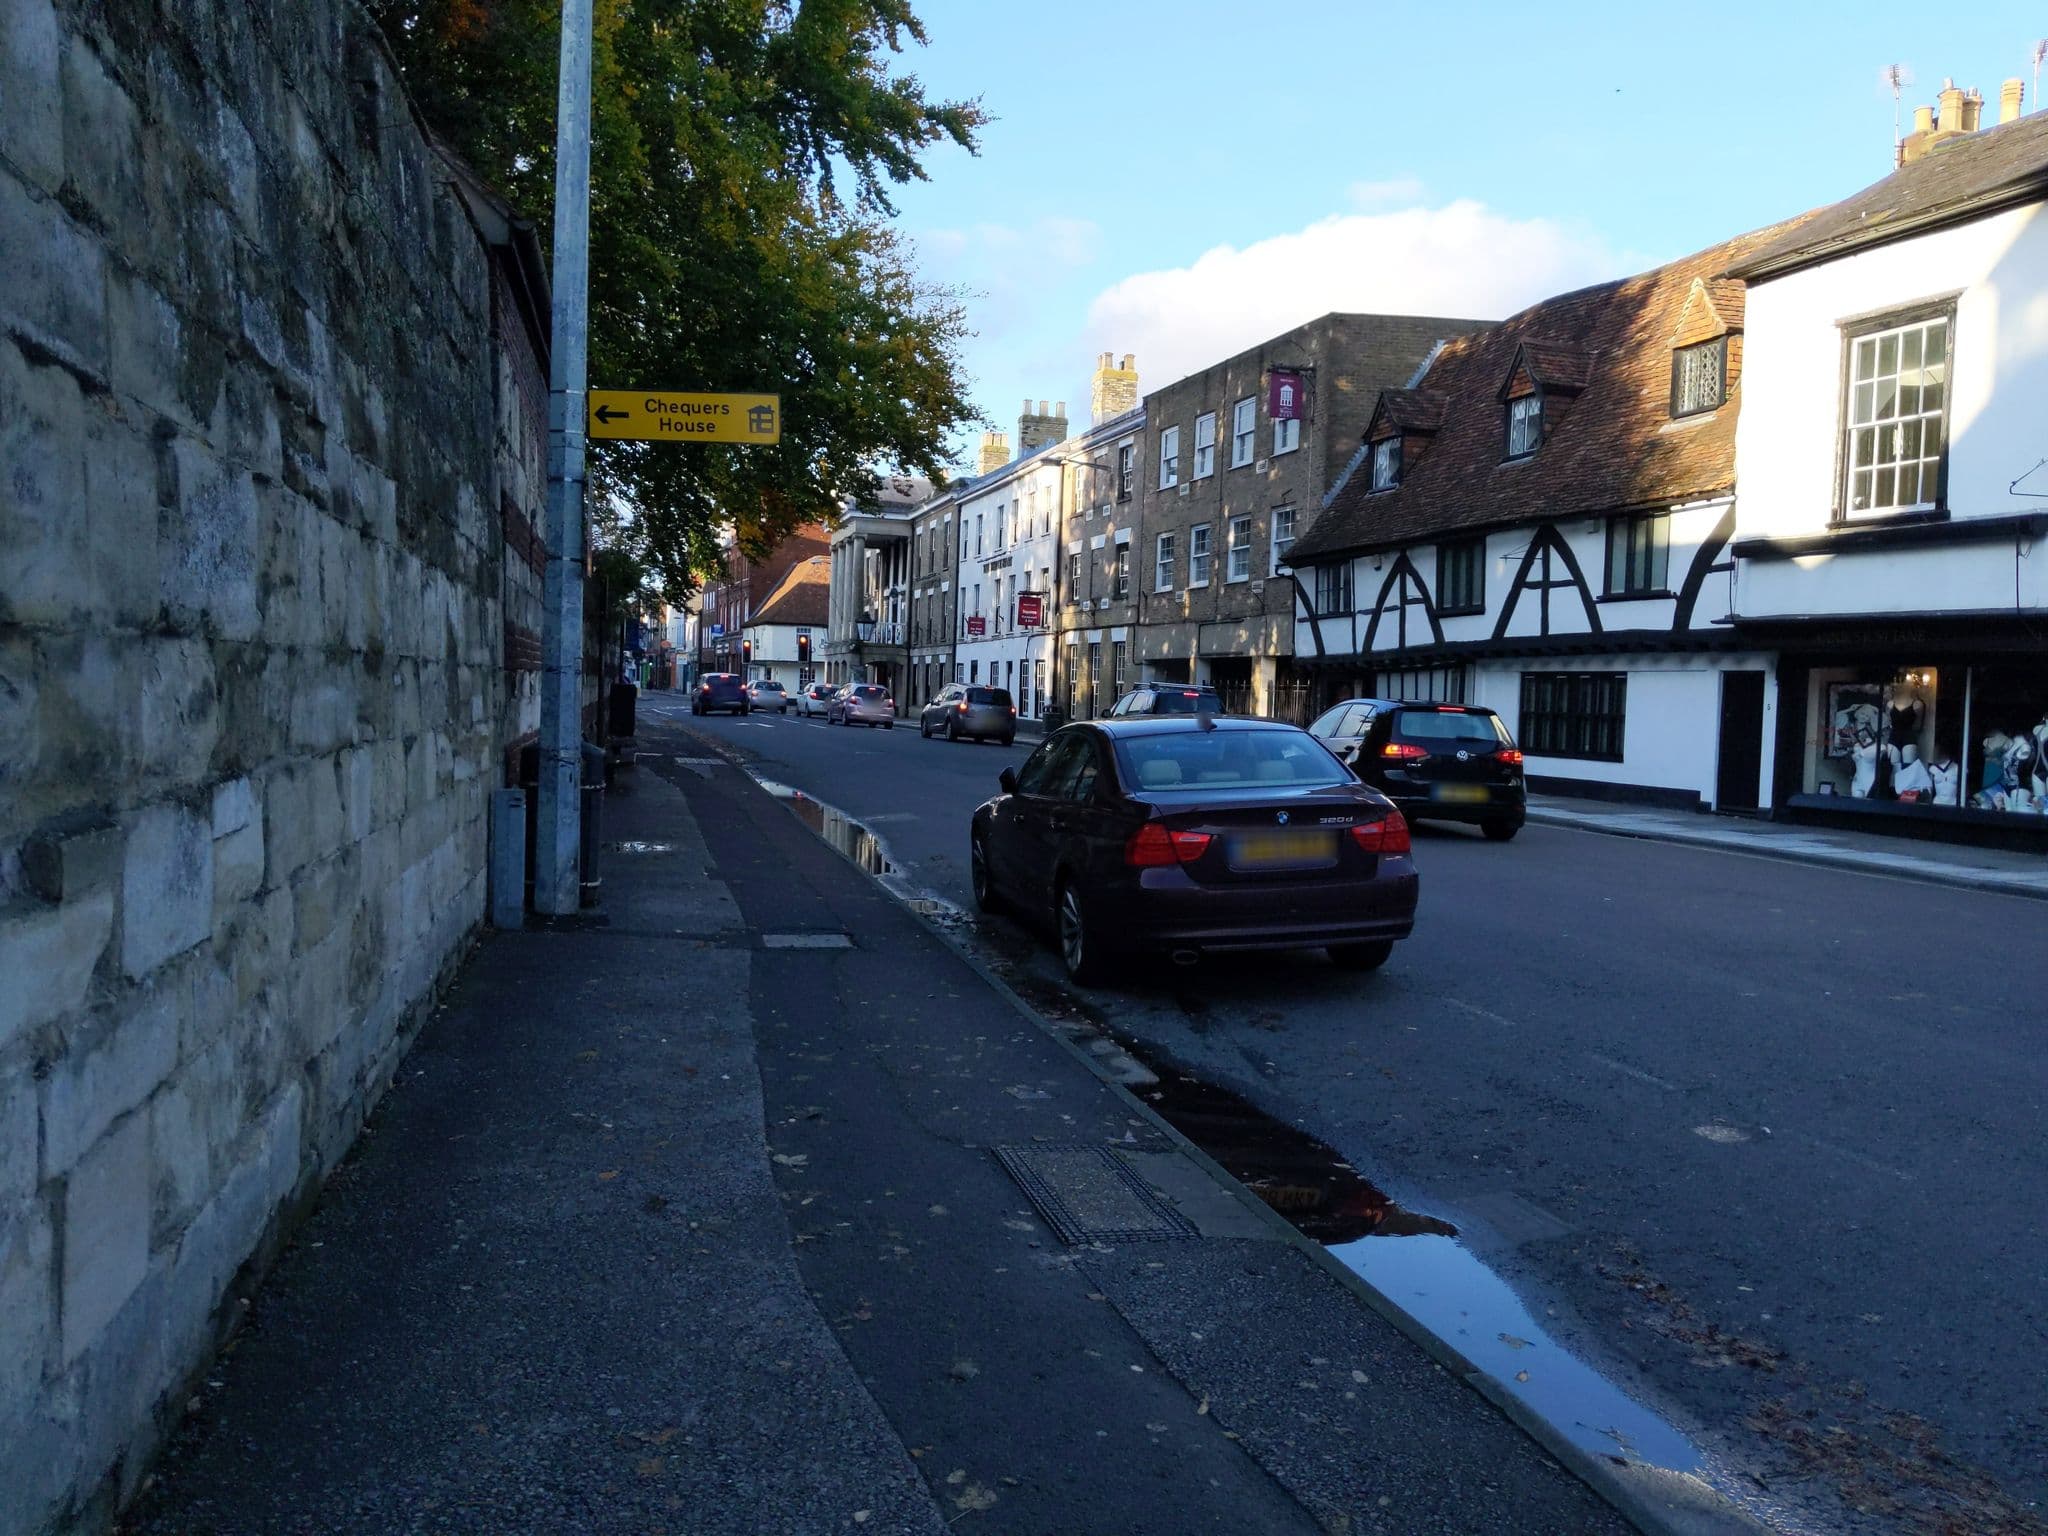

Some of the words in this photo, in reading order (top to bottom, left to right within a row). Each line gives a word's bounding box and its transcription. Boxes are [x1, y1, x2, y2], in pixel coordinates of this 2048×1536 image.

[645, 398, 730, 416] Chequers
[659, 417, 716, 433] House
[1319, 815, 1354, 824] 320d
